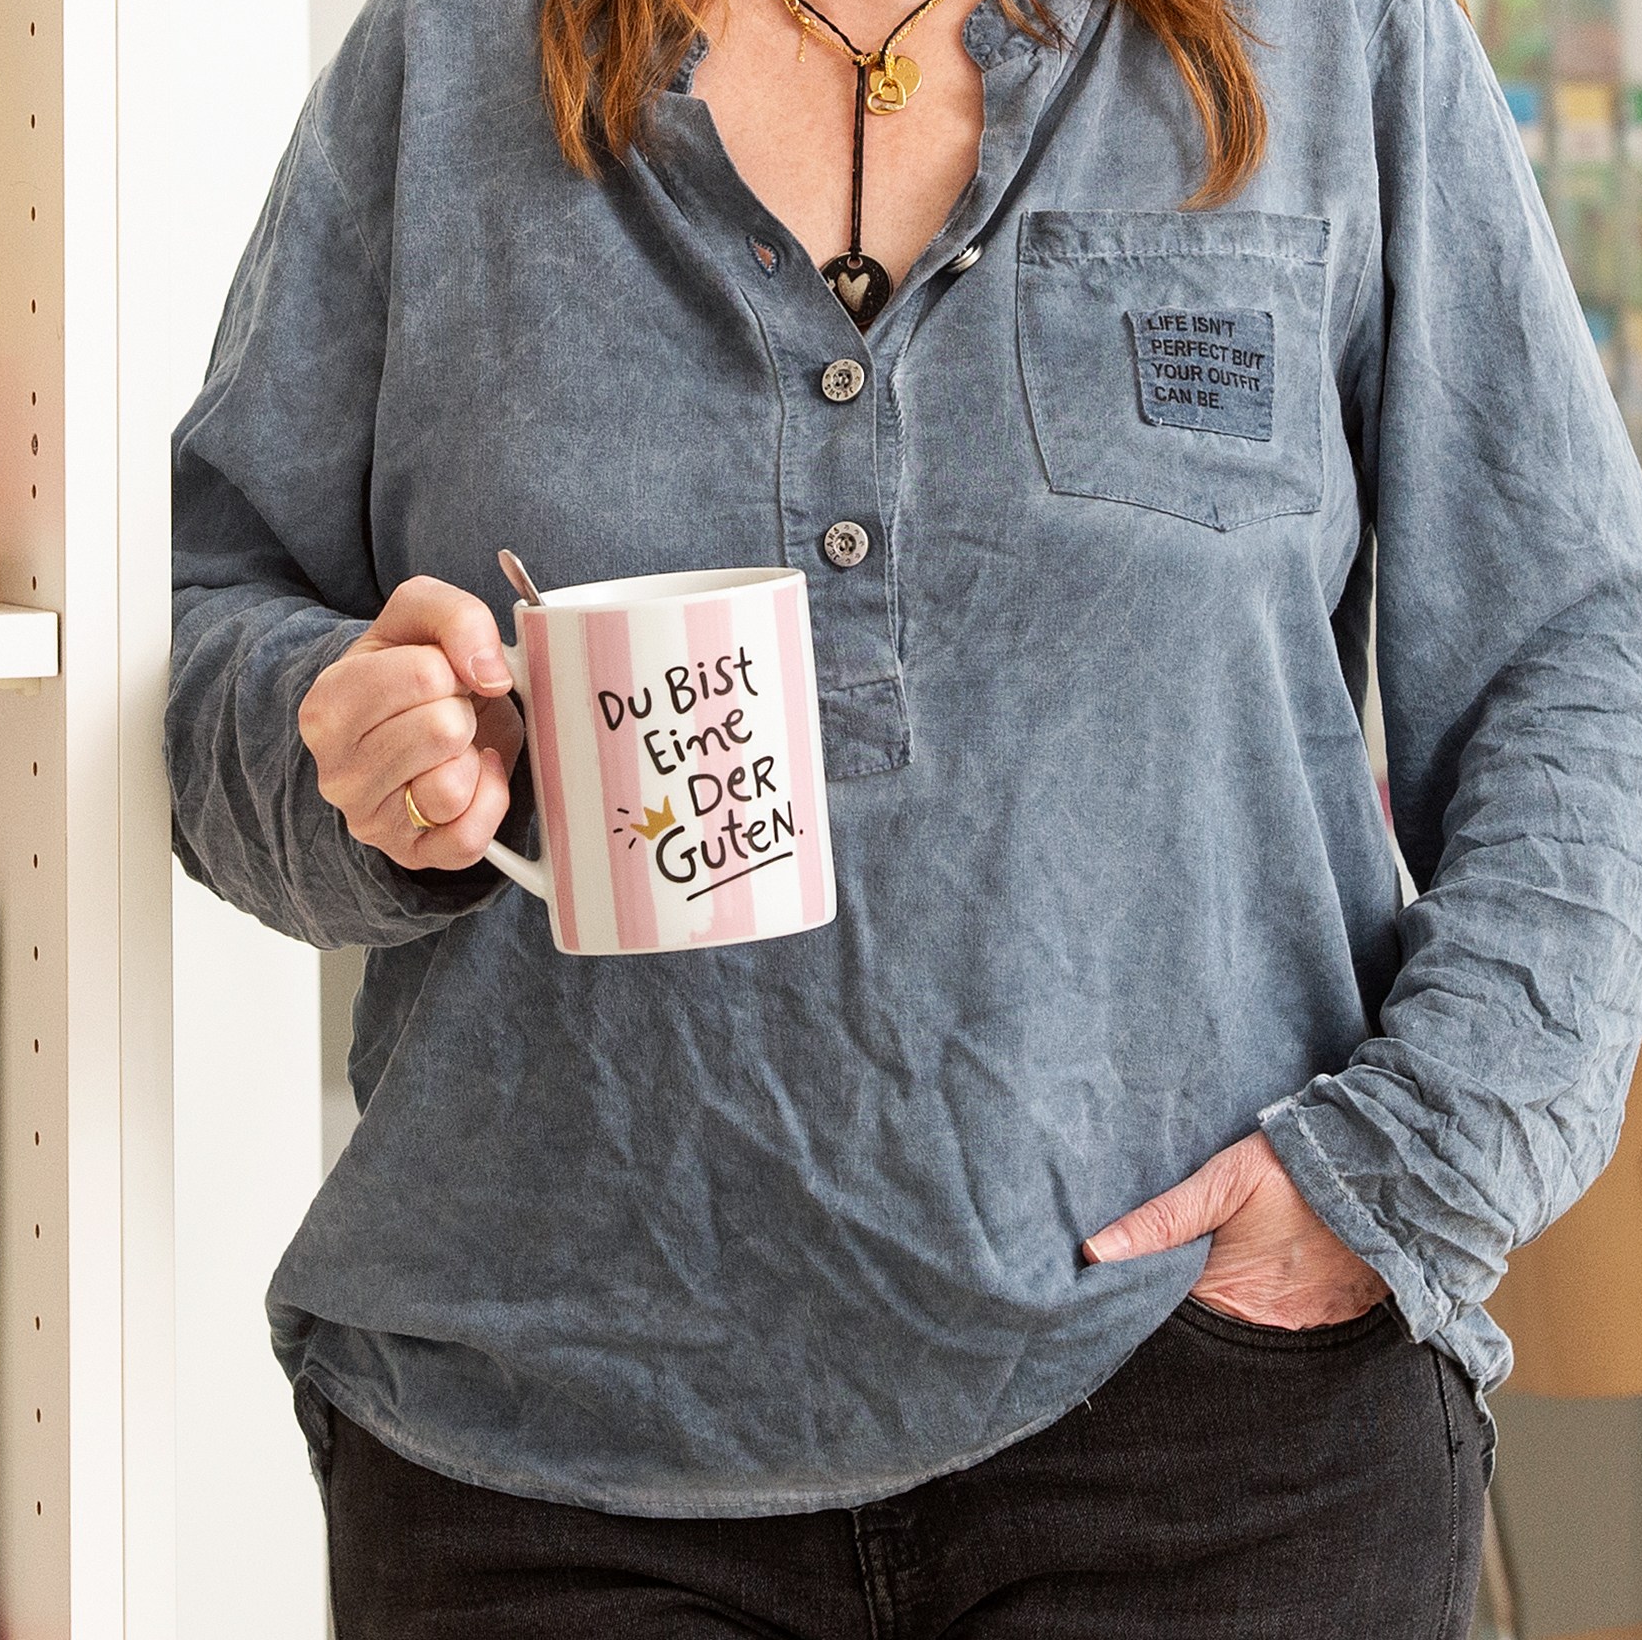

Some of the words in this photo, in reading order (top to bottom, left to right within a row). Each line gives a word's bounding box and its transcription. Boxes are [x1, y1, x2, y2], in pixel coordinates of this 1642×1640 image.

[1147, 314, 1188, 332] LIFE
[1193, 316, 1236, 338] ISN'T
[1151, 339, 1229, 363] PERFECT
[1232, 349, 1265, 371] BUT
[1151, 362, 1203, 382] YOUR
[1207, 368, 1260, 392] OUTFIT
[1155, 386, 1192, 405] CAN
[1197, 391, 1224, 410] BE.
[665, 647, 759, 715] Bist
[643, 708, 753, 776] Eine
